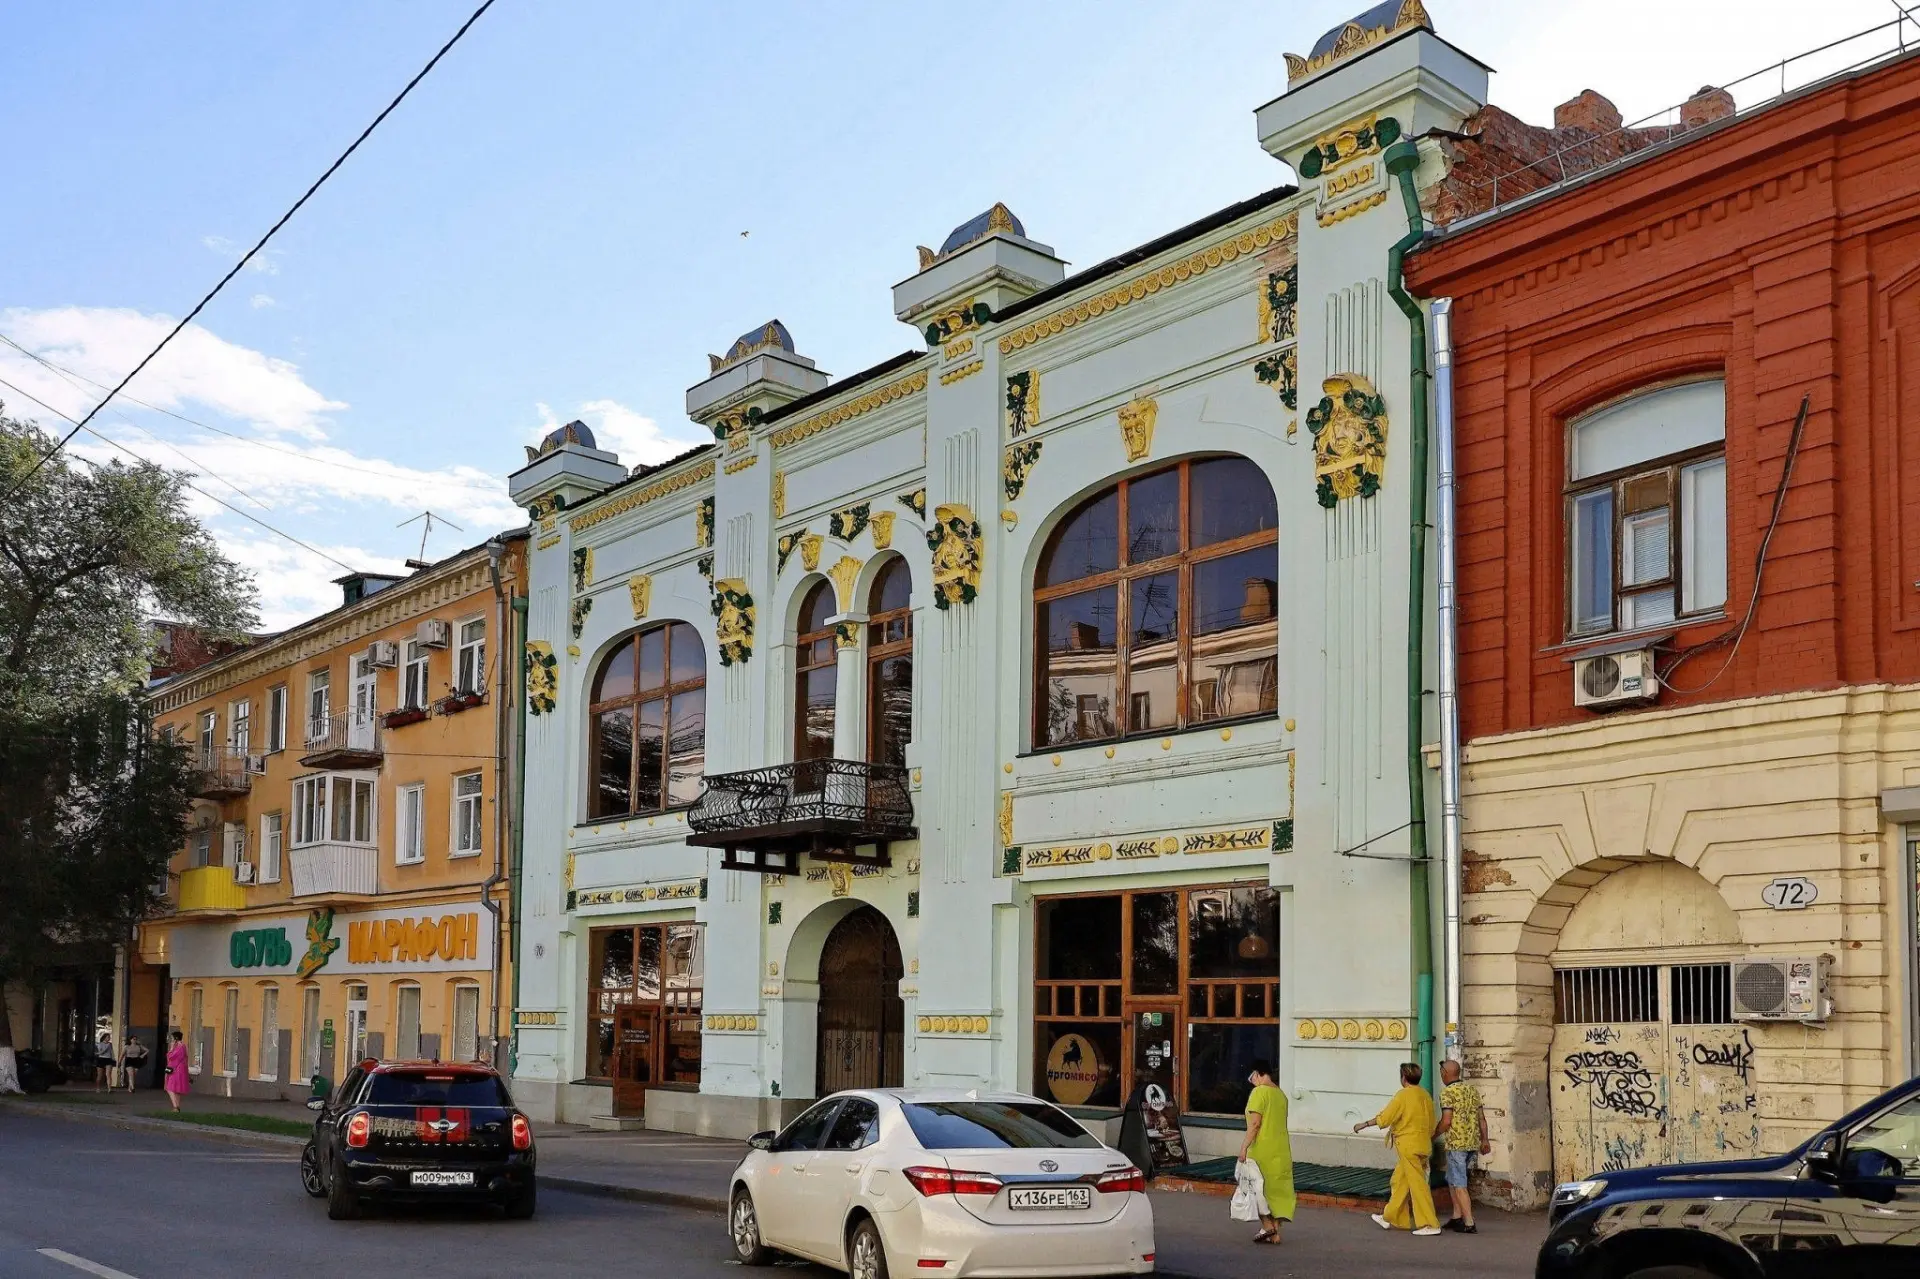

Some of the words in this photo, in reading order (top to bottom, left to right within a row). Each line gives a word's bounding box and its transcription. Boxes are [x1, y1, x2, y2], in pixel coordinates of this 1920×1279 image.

[1776, 883, 1804, 905] 72
[230, 926, 292, 968] ОБУВЬ
[347, 912, 479, 964] МАРАФОН
[456, 1172, 471, 1181] 163
[1067, 1190, 1086, 1201] 163
